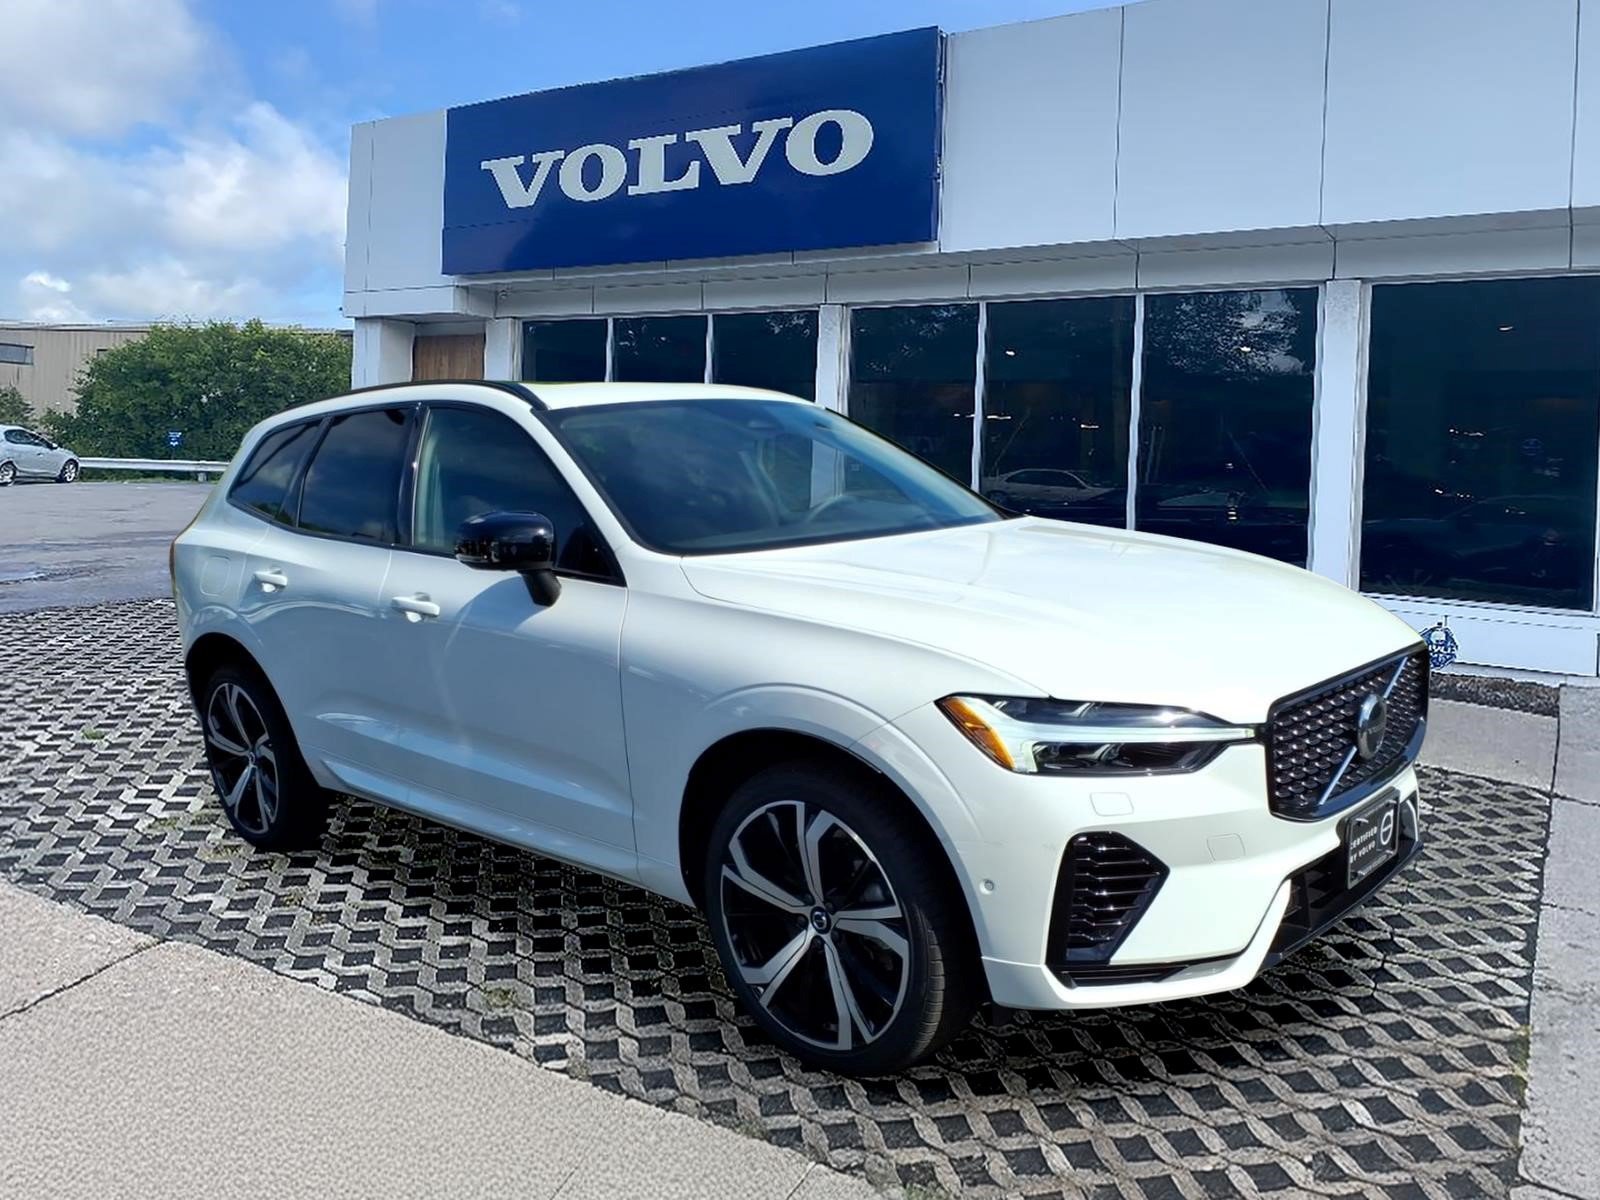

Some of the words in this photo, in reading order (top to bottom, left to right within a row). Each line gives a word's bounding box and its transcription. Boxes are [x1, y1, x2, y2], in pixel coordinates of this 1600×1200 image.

[481, 110, 874, 208] VOLVO
[1350, 826, 1378, 850] CERTIFIED
[1359, 840, 1376, 857] VOLVO
